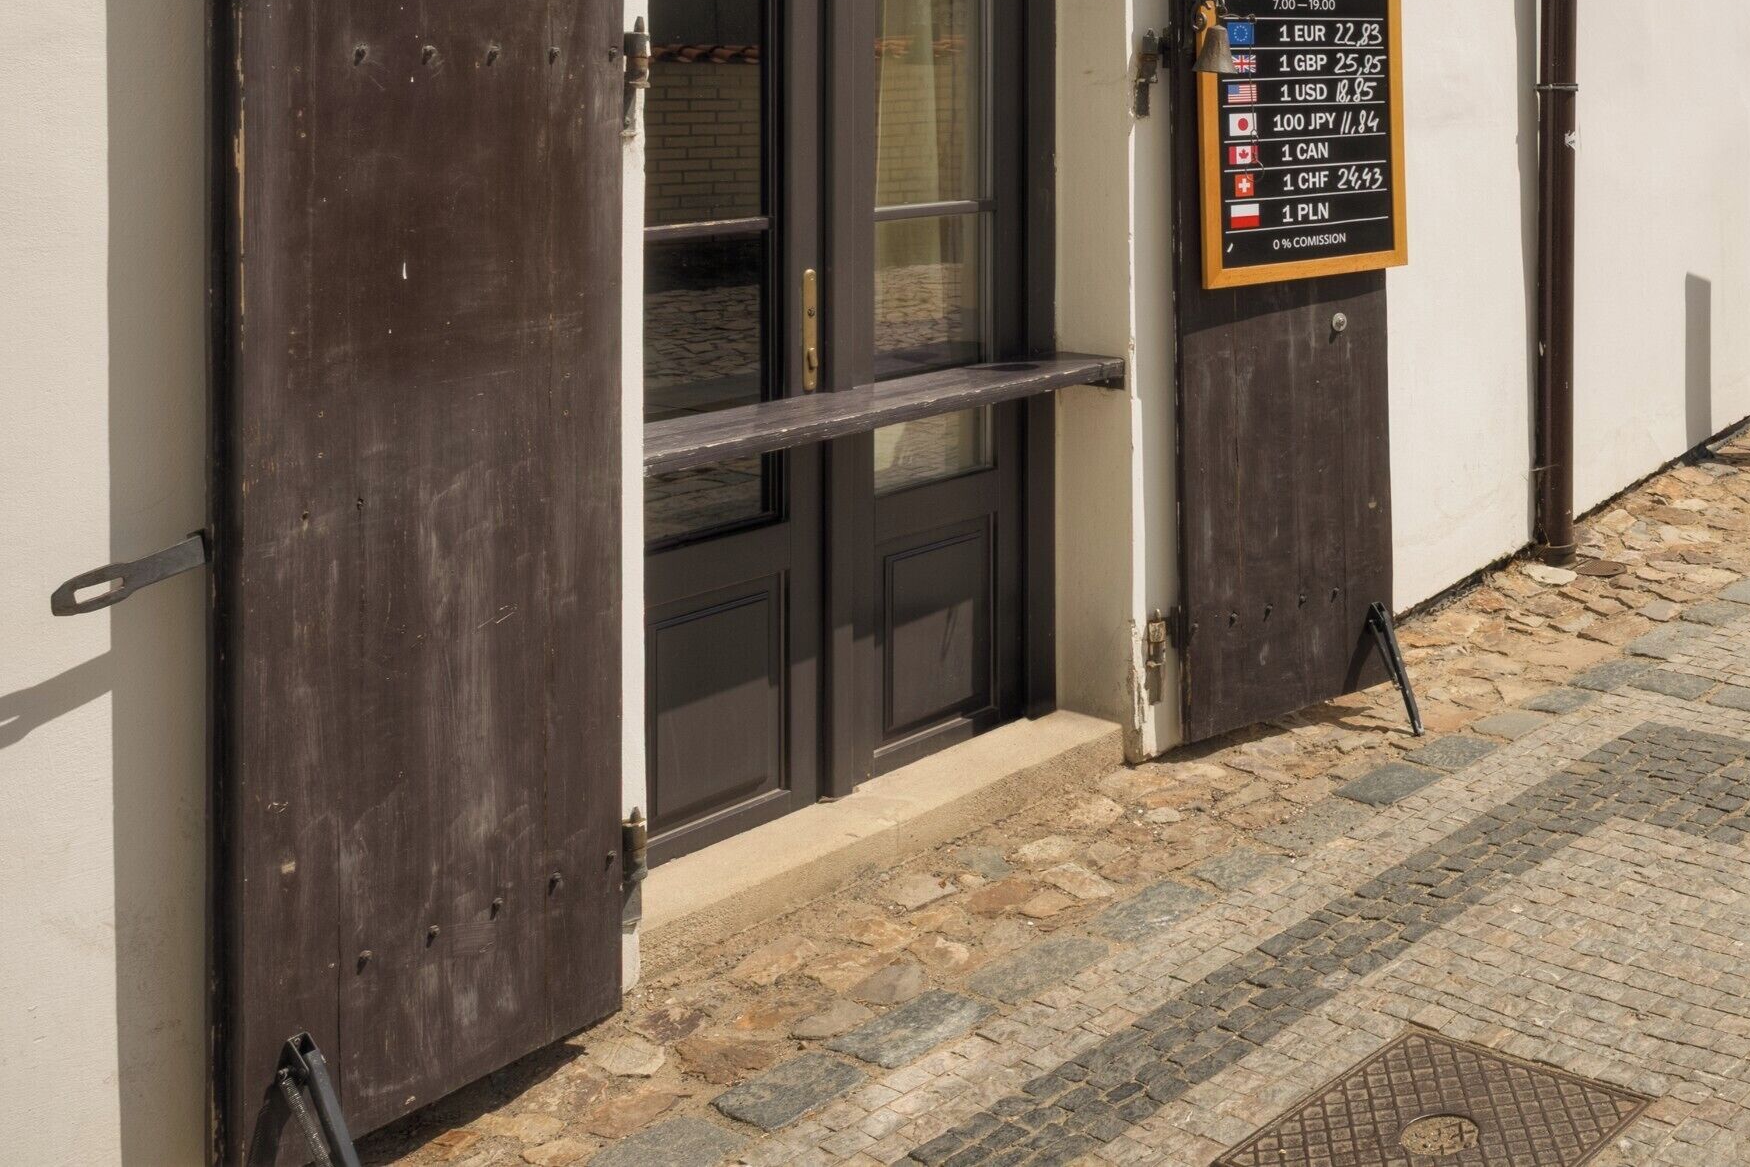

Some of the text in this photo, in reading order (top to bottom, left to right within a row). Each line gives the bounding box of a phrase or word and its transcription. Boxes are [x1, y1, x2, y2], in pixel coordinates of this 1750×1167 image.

[1272, 0, 1295, 10] 7.00
[1309, 0, 1336, 10] 19.00
[1280, 23, 1382, 47] 1 EUR 22,83
[1280, 53, 1387, 76] 1 GBP 25,85
[1281, 77, 1377, 103] 1 USD 18,85
[1273, 110, 1379, 135] 100 JPY 11,84
[1282, 142, 1329, 161] 1 CAN
[1283, 174, 1294, 191] 1
[1298, 171, 1329, 189] CHF
[1282, 202, 1329, 222] 1 PLN
[1273, 232, 1346, 250] 0 % COMISSION
